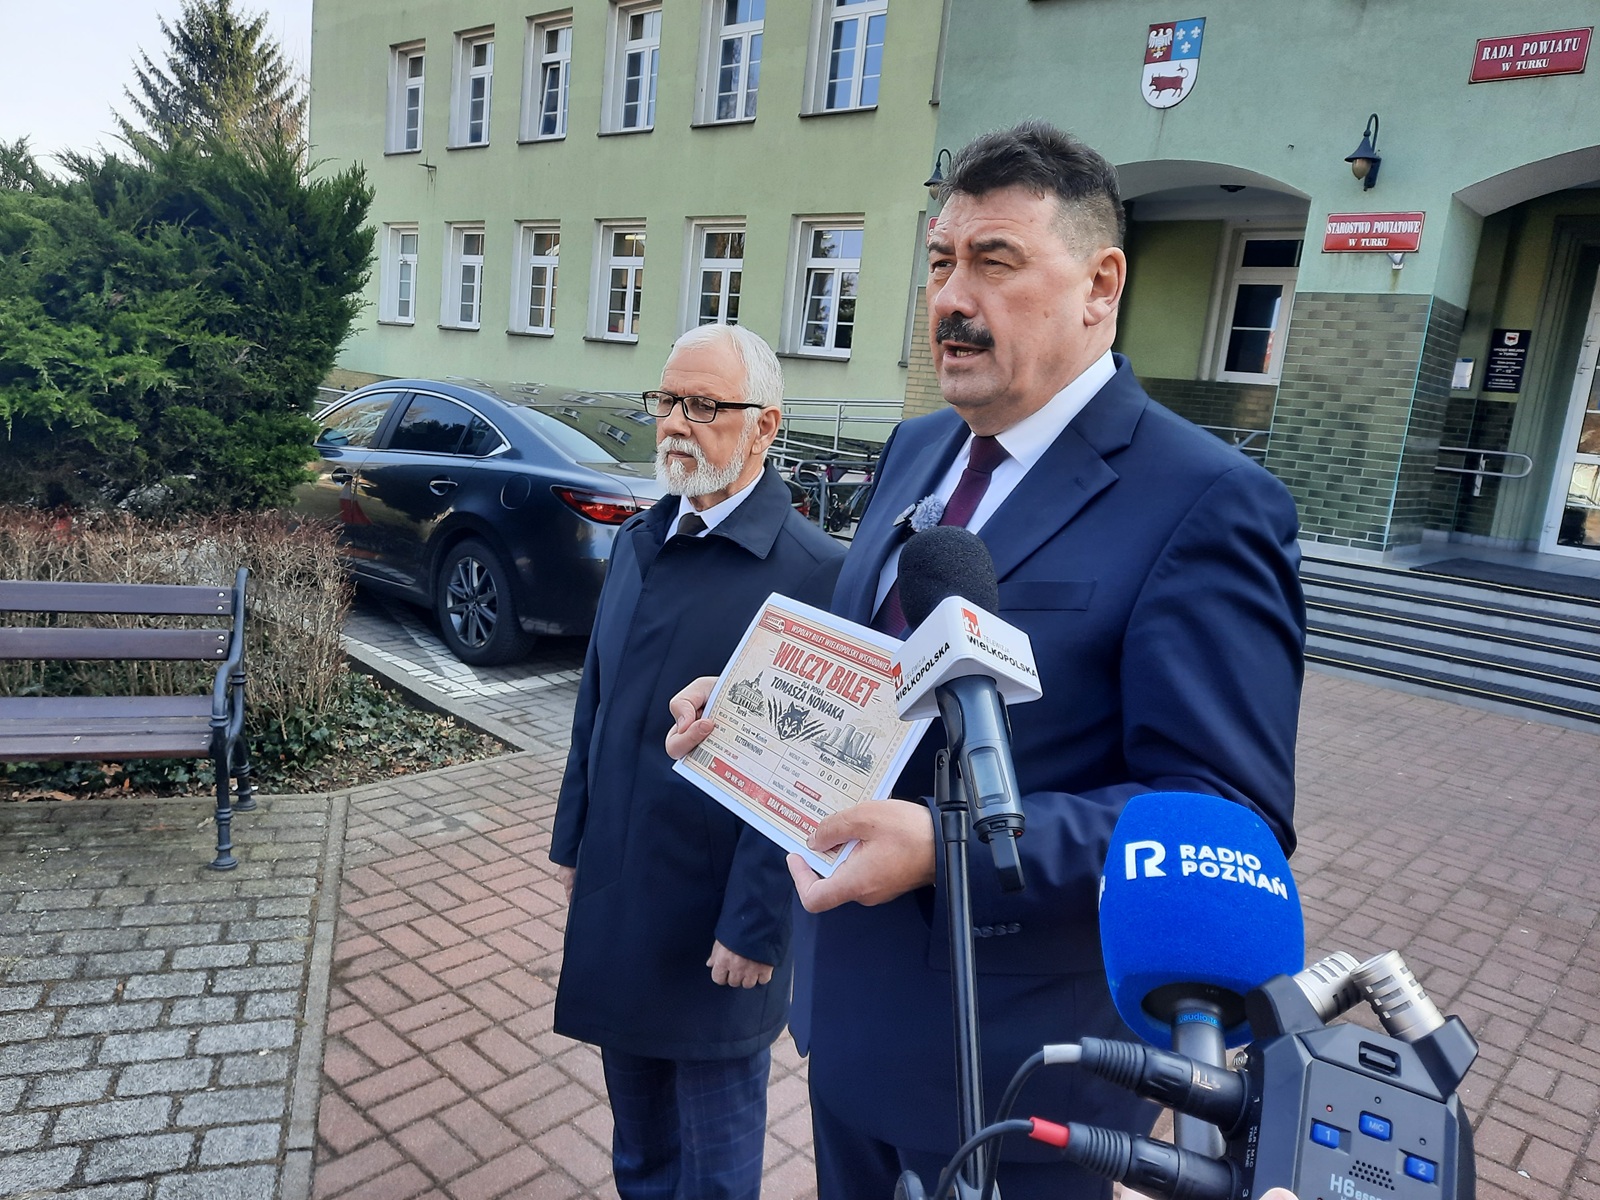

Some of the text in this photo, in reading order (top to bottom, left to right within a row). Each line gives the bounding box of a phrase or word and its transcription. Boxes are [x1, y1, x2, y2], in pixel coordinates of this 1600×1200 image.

[1481, 37, 1581, 61] RADA POWIATU
[1502, 59, 1550, 71] W TURKU
[1326, 220, 1421, 235] STAROSTWO POWIATOWE
[1348, 238, 1389, 247] W TURKU
[772, 641, 881, 707] WILCZY BILET
[801, 680, 810, 689] DLA
[771, 676, 845, 721] TOMASZA NOWAKA
[819, 751, 836, 767] Konin
[767, 797, 780, 811] BRAK
[780, 804, 800, 824] POWROTU
[1125, 840, 1166, 880] R
[1179, 845, 1262, 870] RADIO
[1182, 861, 1289, 901] POZNAŃ
[1369, 1120, 1384, 1133] MIC
[1325, 1130, 1331, 1141] 1
[1418, 1163, 1426, 1175] 2
